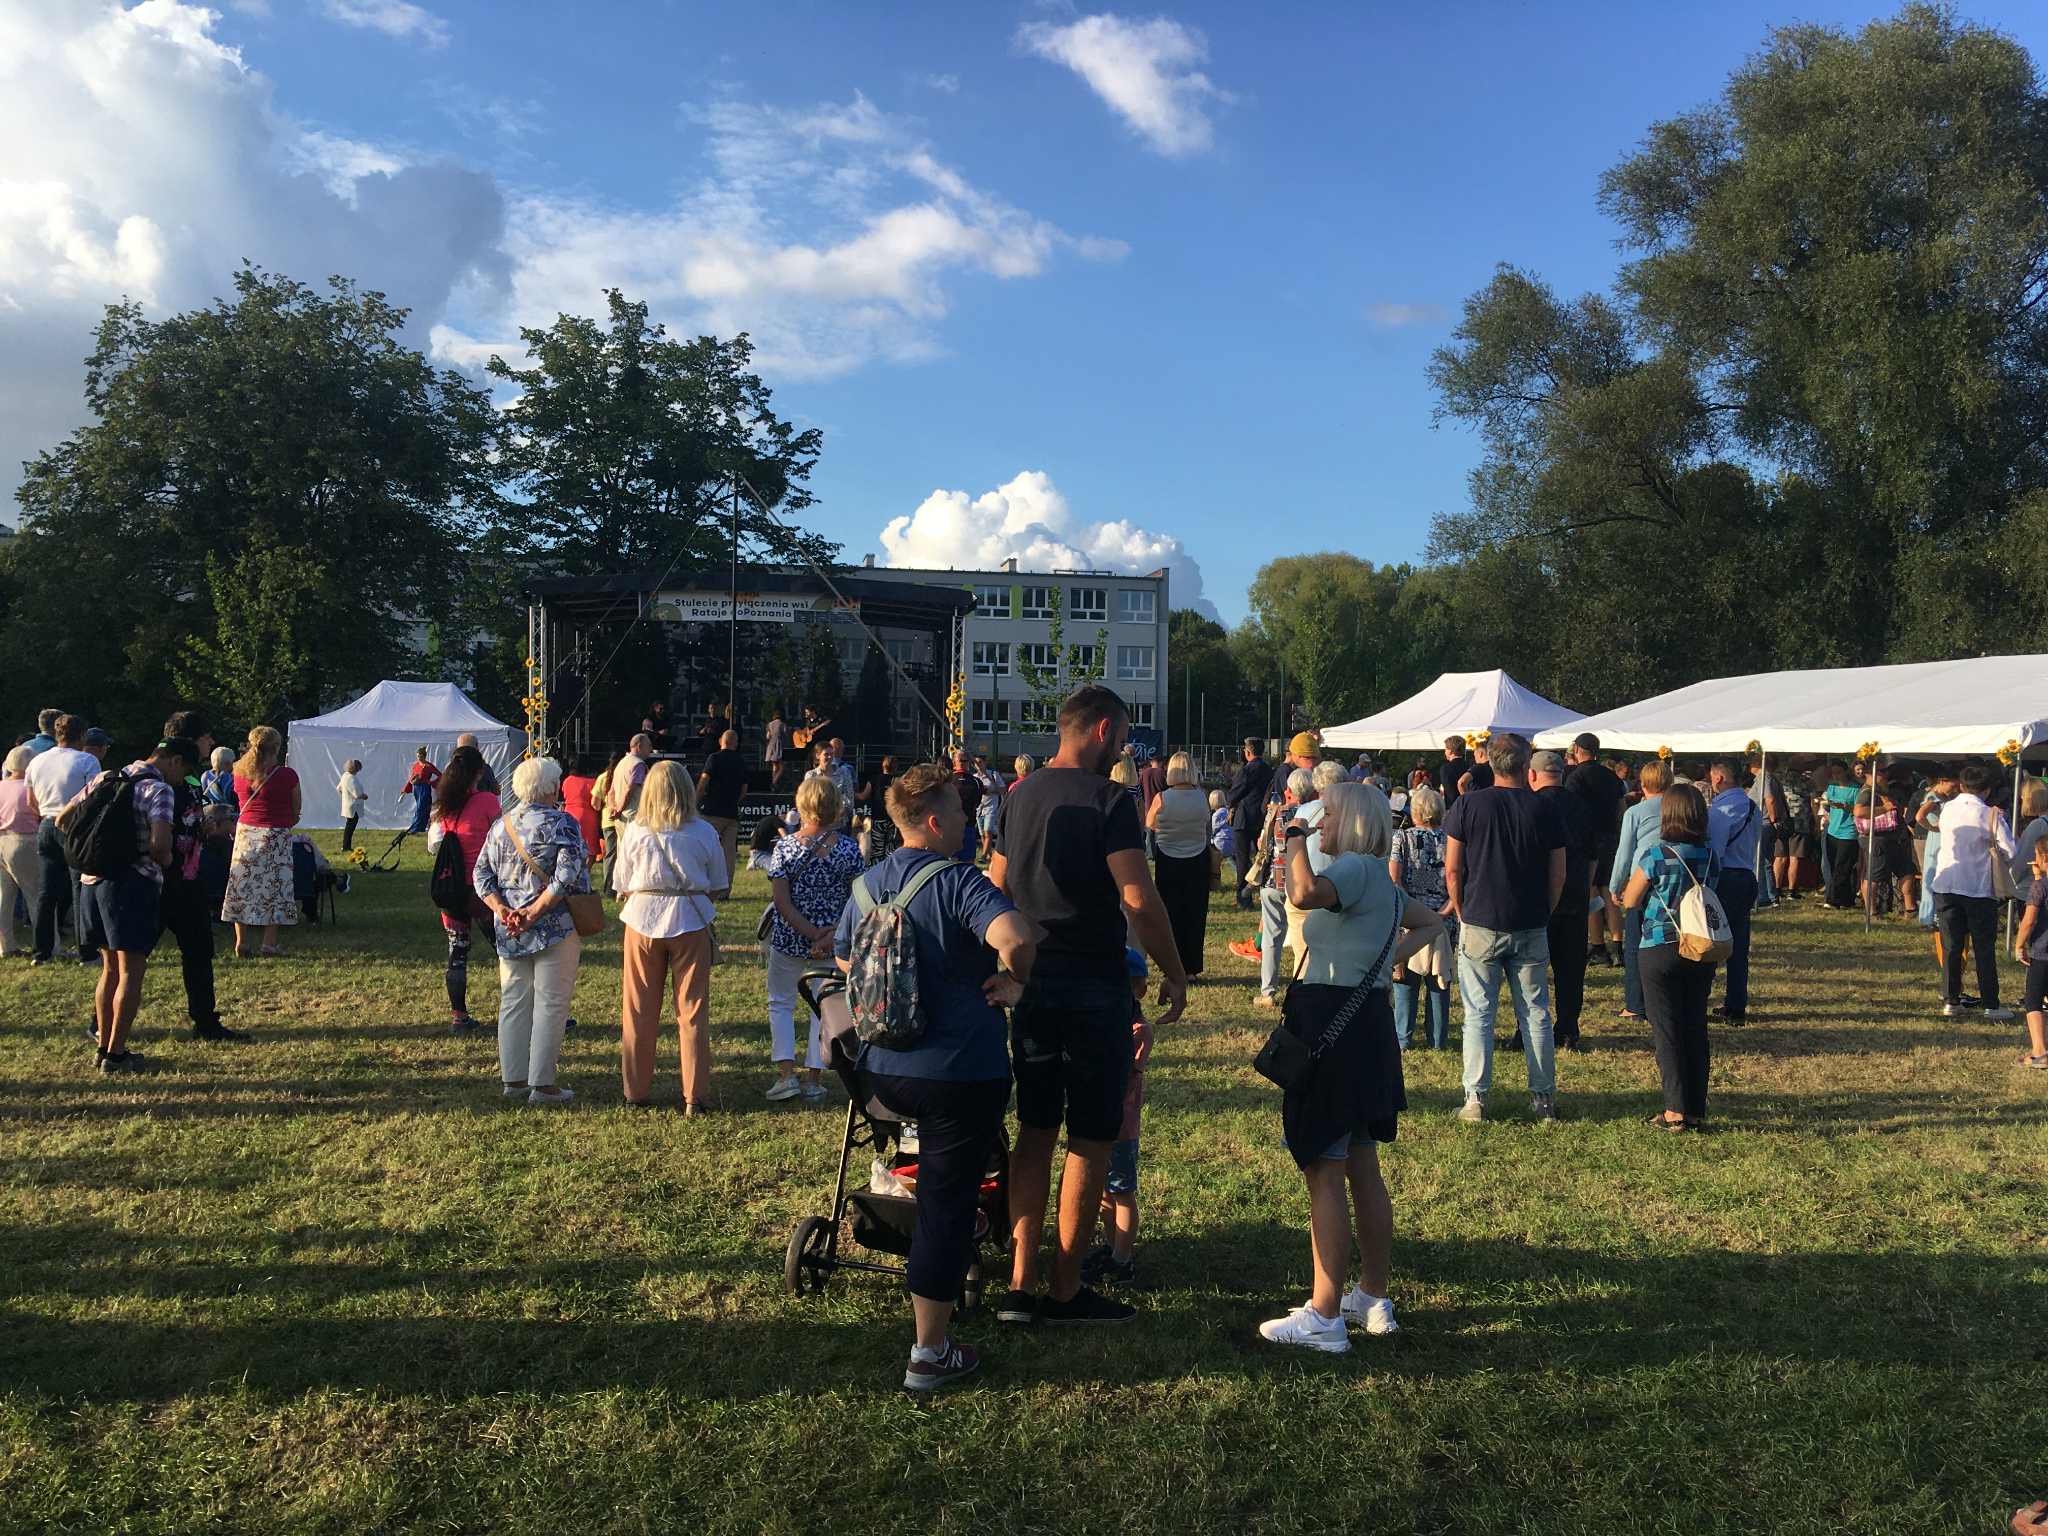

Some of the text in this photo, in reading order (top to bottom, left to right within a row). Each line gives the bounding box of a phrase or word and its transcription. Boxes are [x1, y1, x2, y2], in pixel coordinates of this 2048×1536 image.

[674, 598, 809, 609] Stulecie pryłączenia wsi
[691, 608, 727, 618] Rataje
[737, 804, 772, 816] vents
